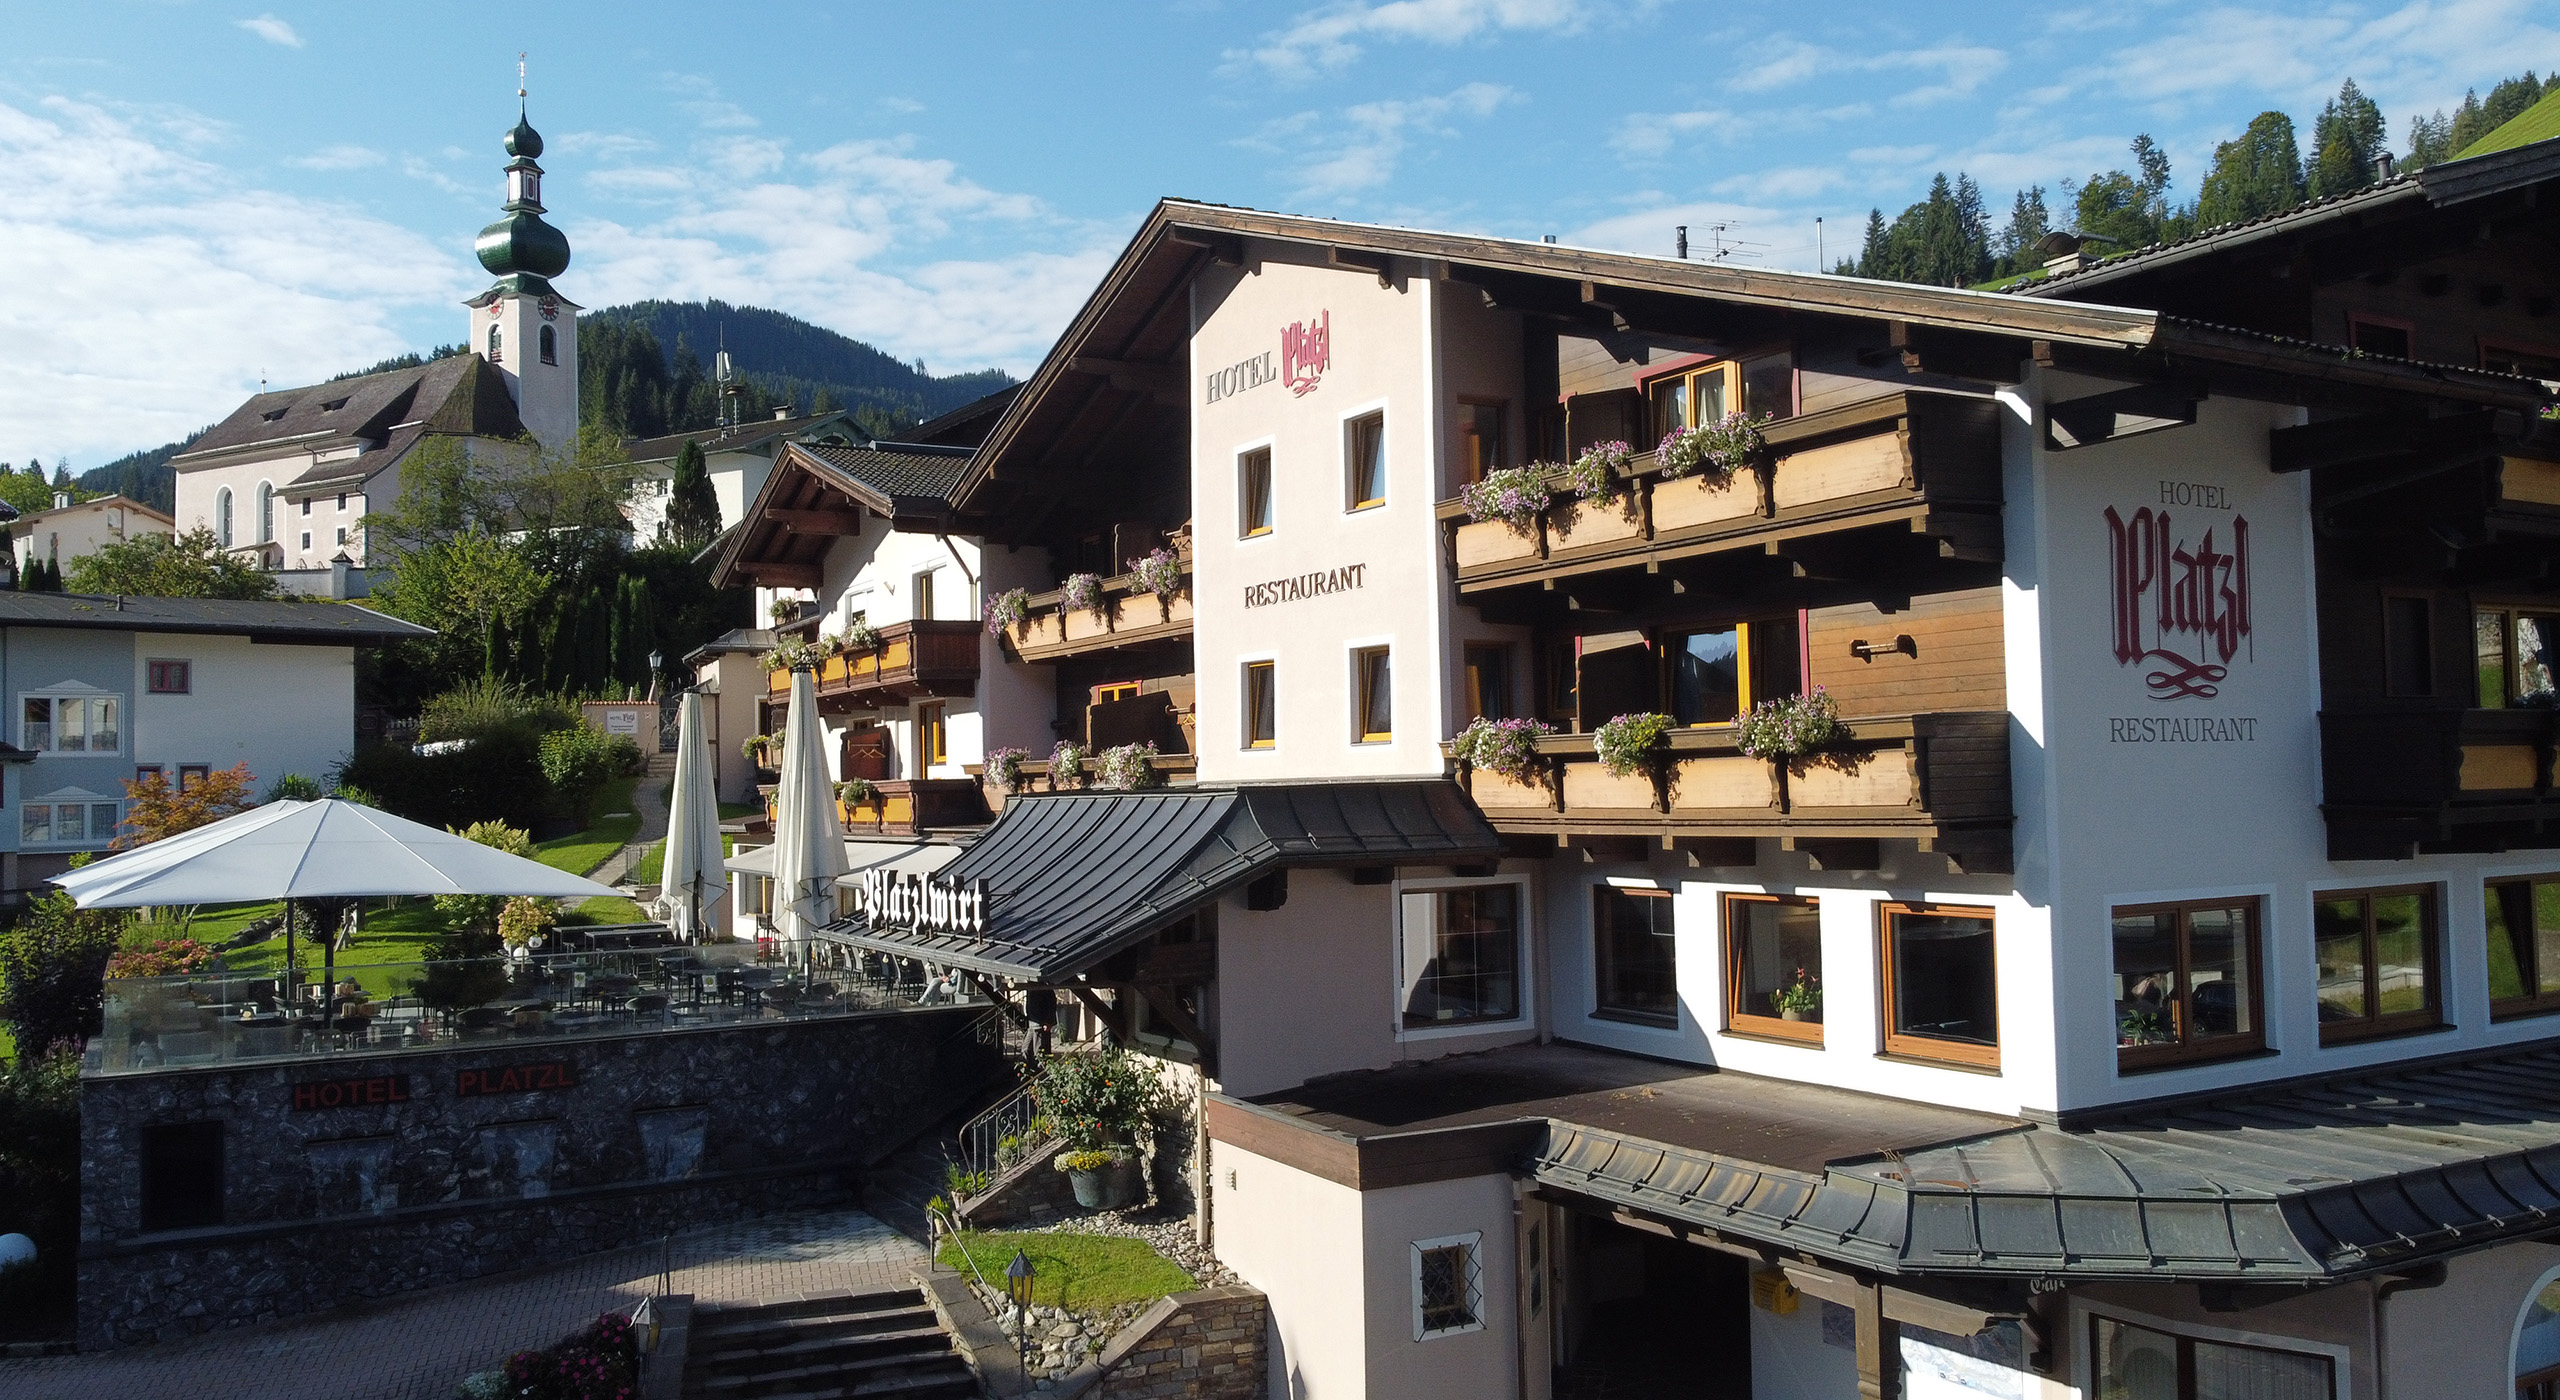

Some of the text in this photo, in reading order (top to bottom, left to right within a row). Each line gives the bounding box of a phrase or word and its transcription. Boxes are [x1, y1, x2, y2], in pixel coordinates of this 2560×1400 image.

[1206, 351, 1276, 404] HOTEL
[2159, 480, 2232, 510] HOTEL
[1244, 562, 1366, 609] RESTAURANT
[2104, 504, 2253, 667] Platzl
[2109, 717, 2257, 742] RESTAURANT
[862, 867, 983, 936] Platzlwirt
[295, 1064, 574, 1108] HOTEL PLATZL
[2030, 1278, 2066, 1295] Caf
